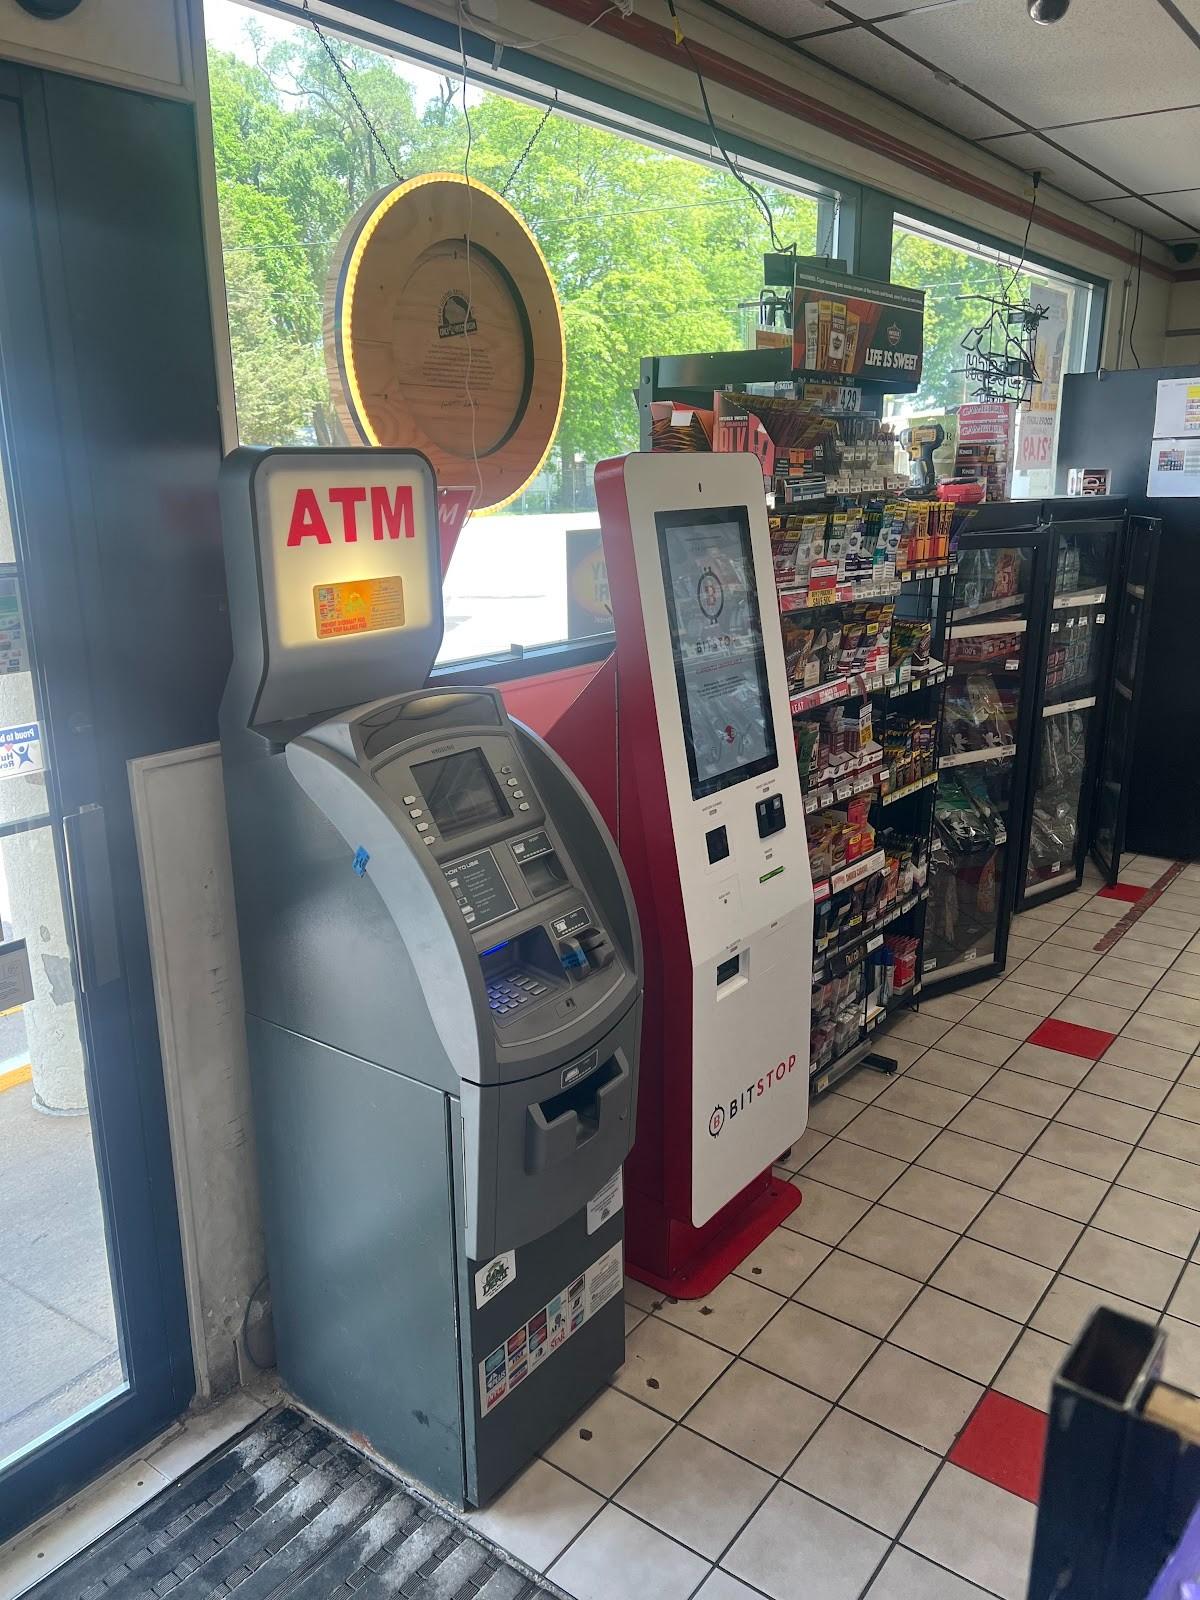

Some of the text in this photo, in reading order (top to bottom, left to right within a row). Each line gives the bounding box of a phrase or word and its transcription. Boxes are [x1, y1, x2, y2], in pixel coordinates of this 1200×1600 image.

[865, 348, 918, 371] LIFE IS SWEET
[287, 486, 415, 547] ATM
[445, 859, 480, 877] HOW TO USE
[729, 1054, 796, 1119] BITSTOP
